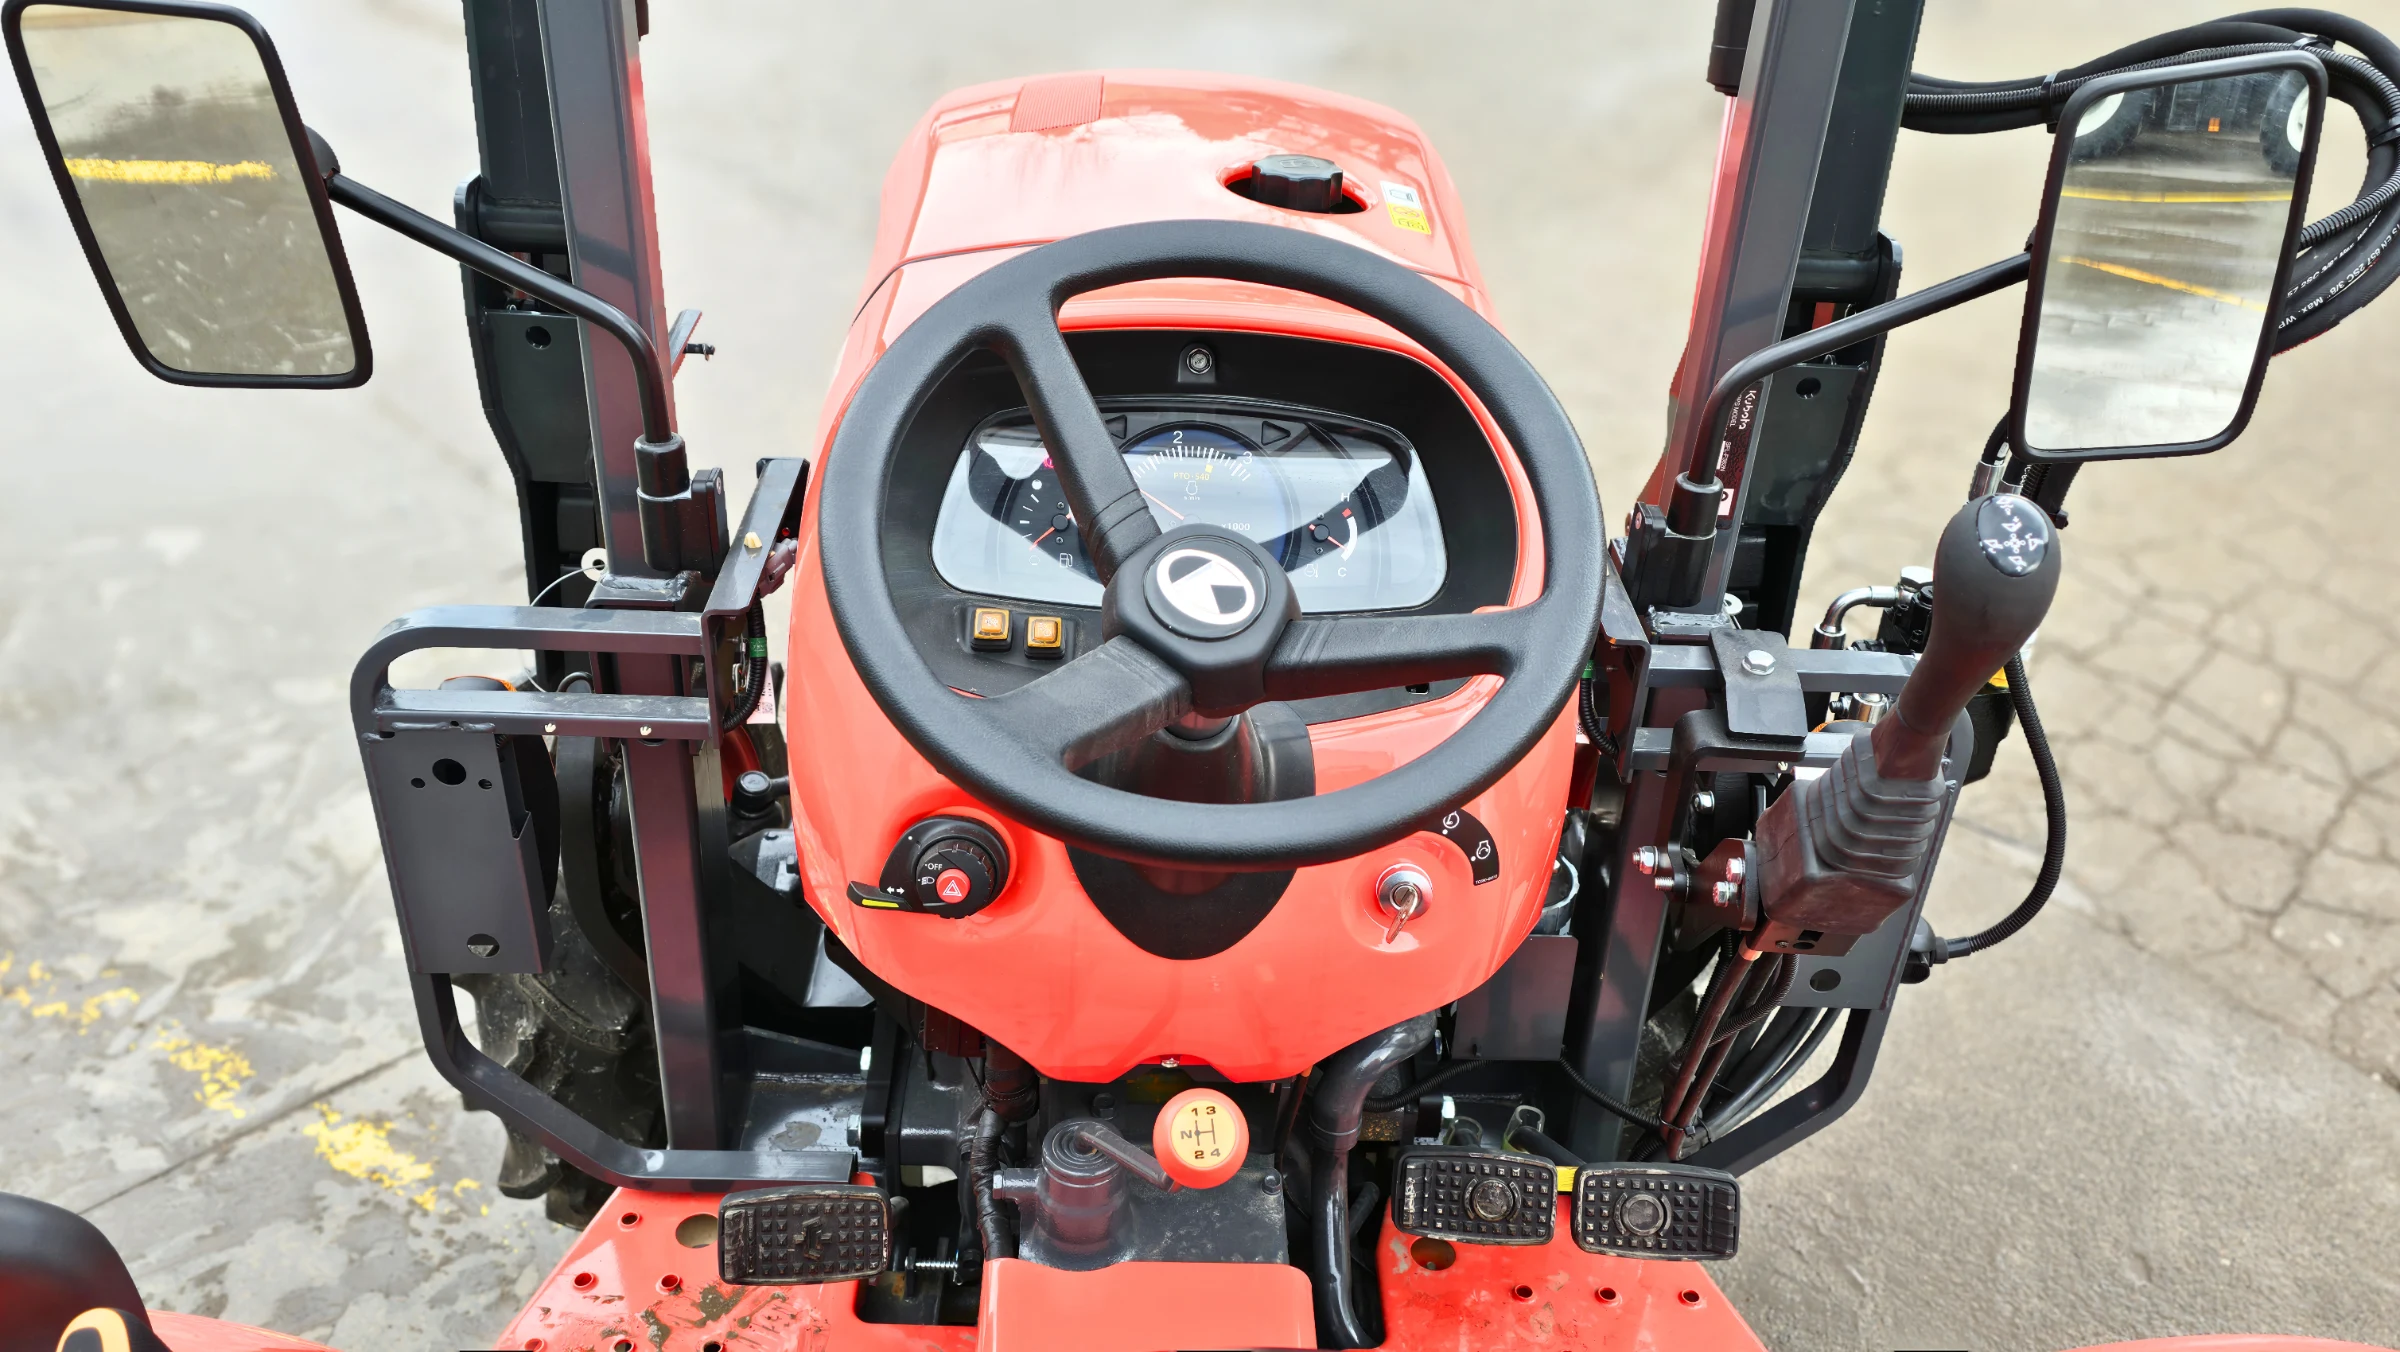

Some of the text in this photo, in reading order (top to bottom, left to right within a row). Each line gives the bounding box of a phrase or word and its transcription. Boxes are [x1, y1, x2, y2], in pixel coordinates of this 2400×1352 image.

[2346, 263, 2366, 282] 2SC
[2297, 296, 2324, 314] Max.
[1739, 390, 1756, 429] Kubota
[1173, 430, 1183, 444] 2
[1242, 451, 1253, 464] 3
[1173, 472, 1210, 481] PTO 540
[1341, 493, 1350, 502] H
[1337, 567, 1347, 577] C
[928, 862, 942, 870] OFF
[1191, 1106, 1216, 1116] 1 3
[1180, 1130, 1192, 1139] N
[1194, 1148, 1220, 1159] 2 4
